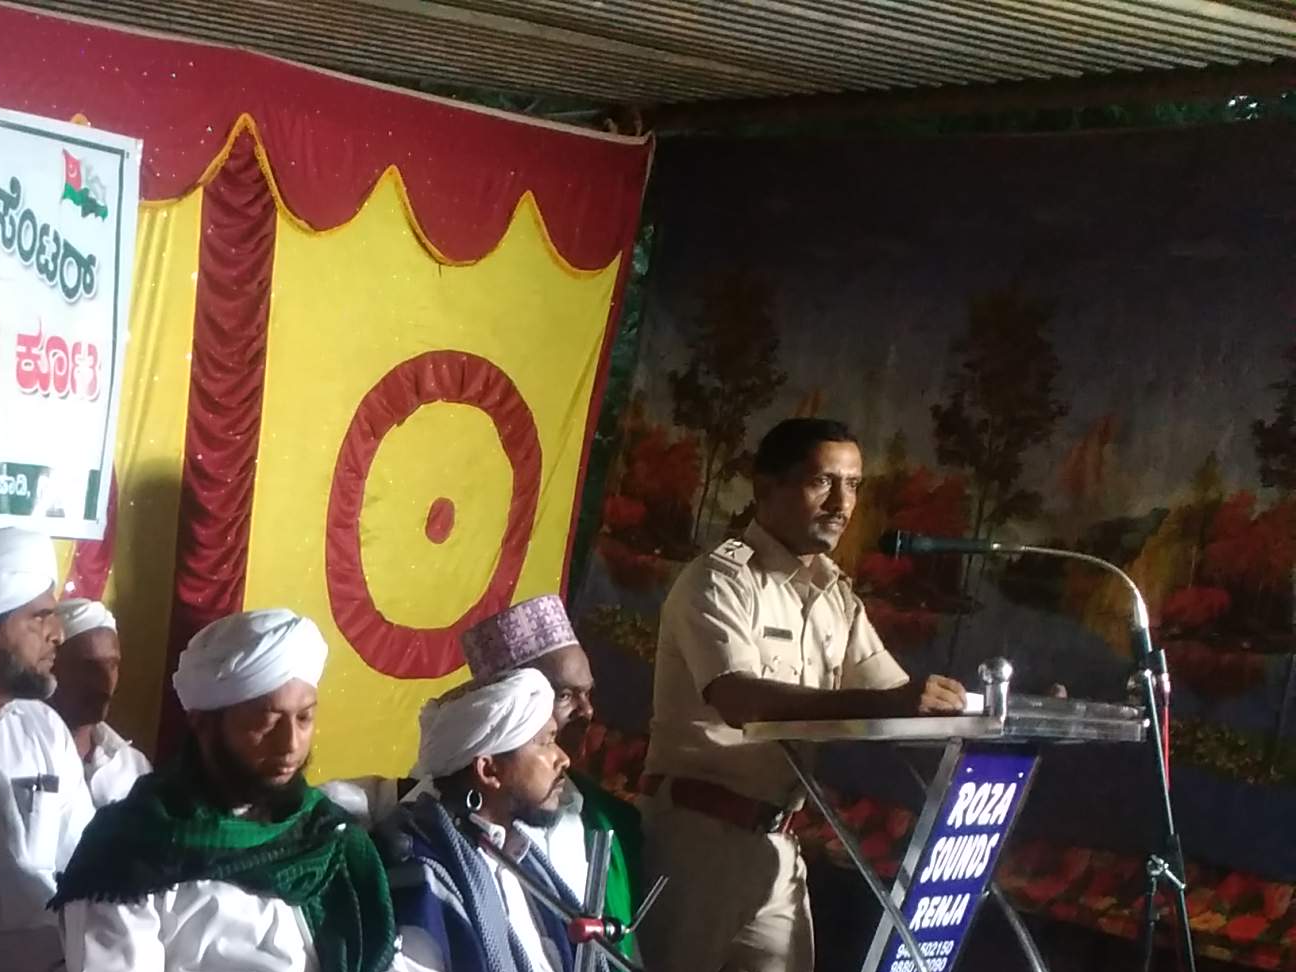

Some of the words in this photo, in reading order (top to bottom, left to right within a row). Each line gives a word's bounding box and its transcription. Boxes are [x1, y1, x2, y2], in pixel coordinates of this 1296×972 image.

[946, 782, 1017, 828] ROZA
[919, 833, 1000, 883] SOUNDS
[909, 893, 970, 932] RENJA
